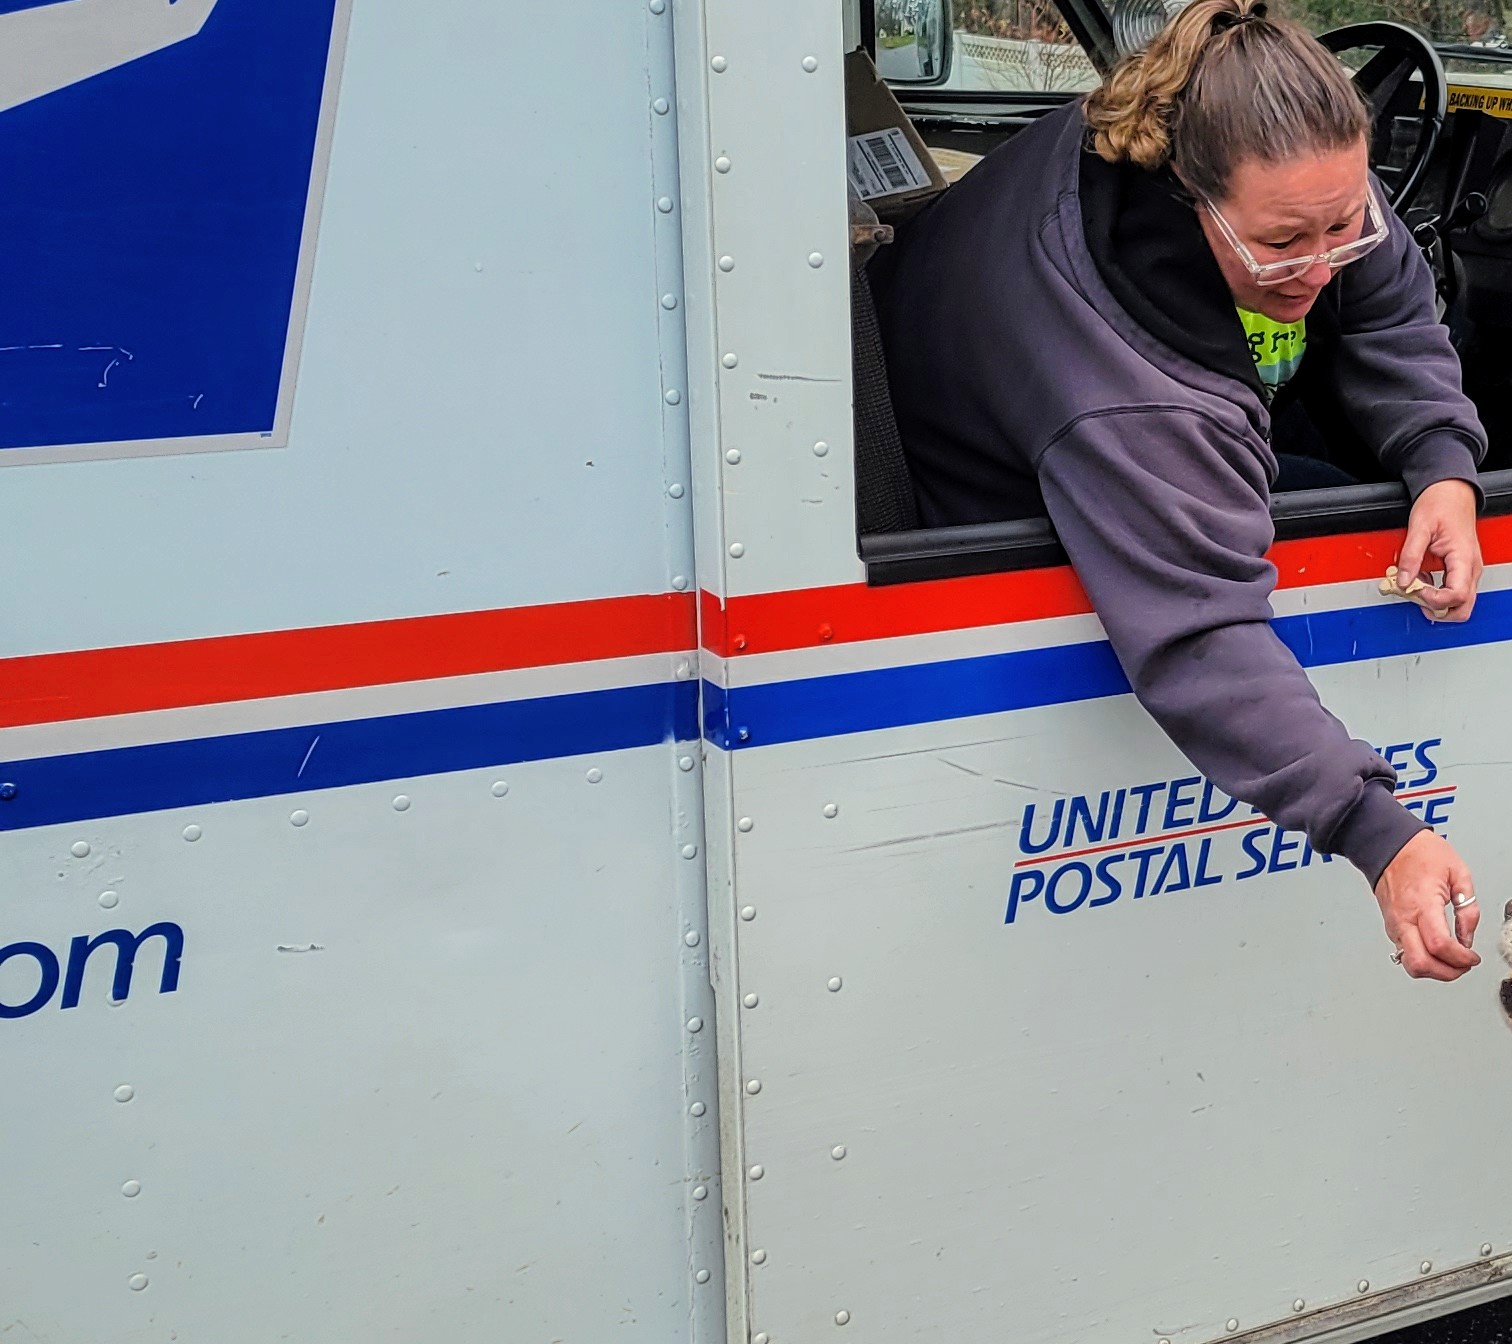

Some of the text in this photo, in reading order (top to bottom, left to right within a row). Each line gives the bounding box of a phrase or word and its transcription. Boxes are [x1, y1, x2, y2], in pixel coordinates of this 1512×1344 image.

[1449, 93, 1484, 109] BACKING
[1485, 96, 1499, 110] UP
[1018, 773, 1239, 855] UNITED
[1004, 837, 1224, 925] POSTAL
